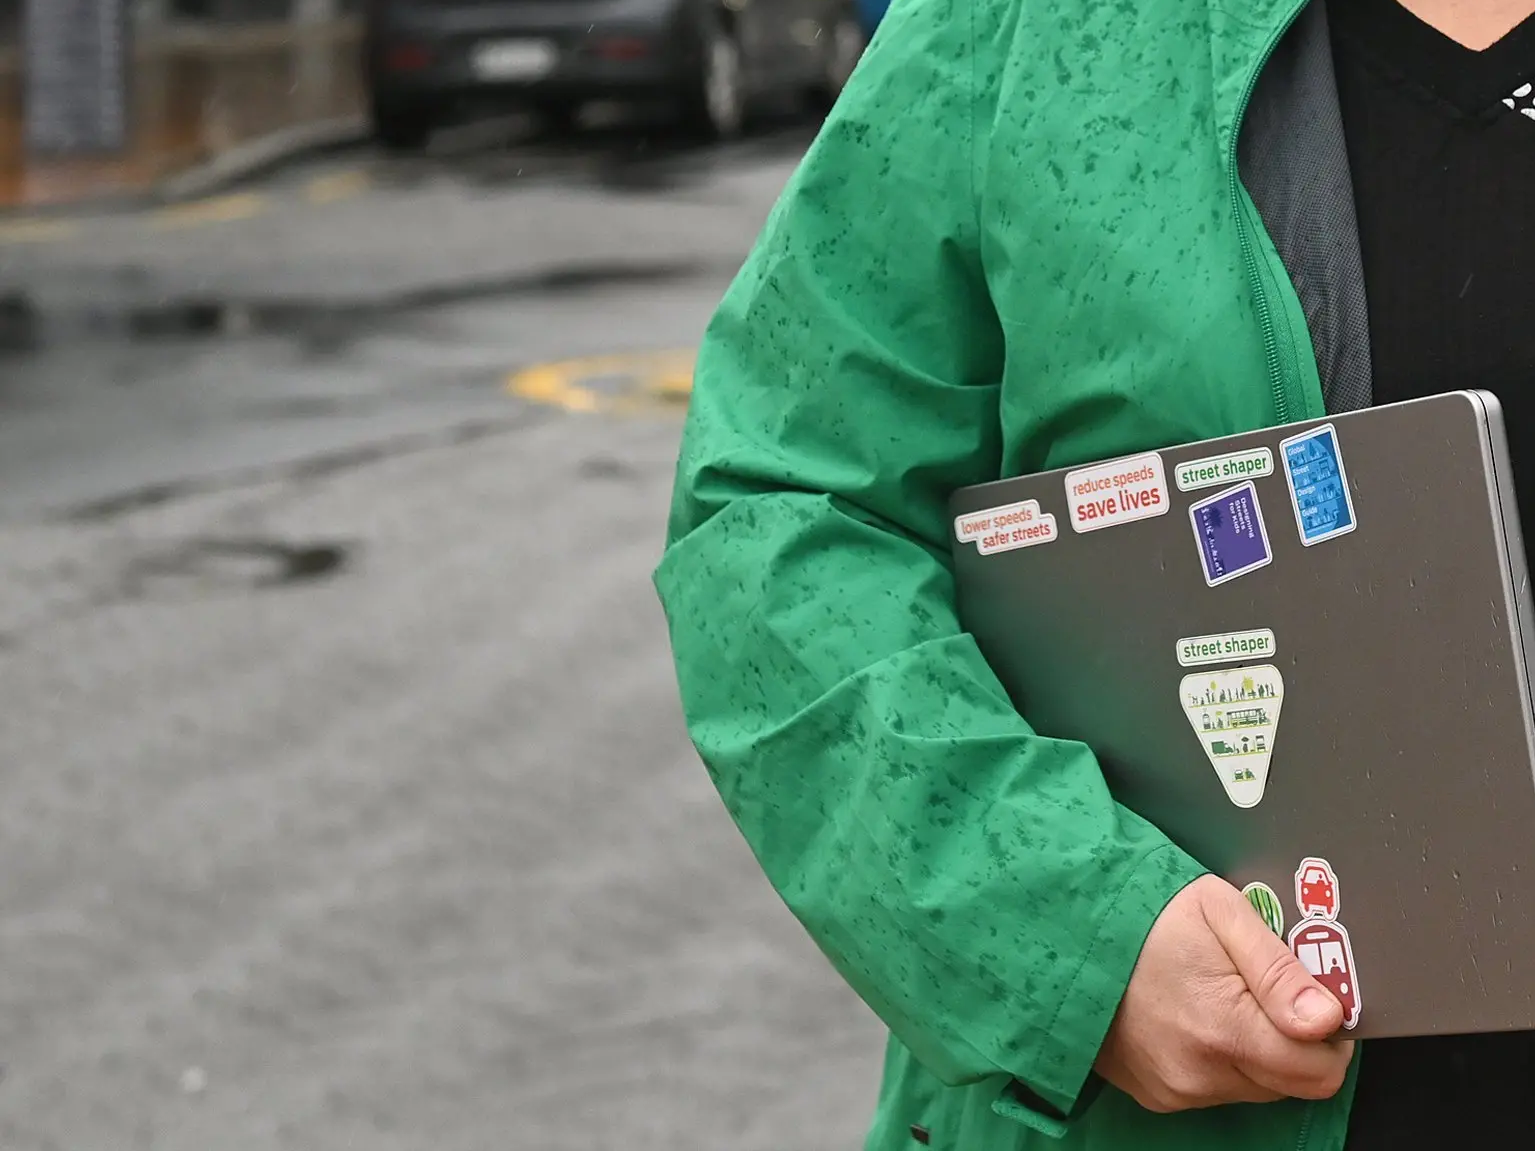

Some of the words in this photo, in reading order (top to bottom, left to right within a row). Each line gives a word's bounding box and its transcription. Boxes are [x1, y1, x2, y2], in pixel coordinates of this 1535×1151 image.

[1073, 477, 1111, 496] reduce
[1113, 465, 1154, 488] speeds
[1182, 463, 1220, 484] street
[1223, 457, 1266, 476] shaper
[1077, 497, 1117, 521] save
[1119, 488, 1160, 511] lives
[1234, 500, 1246, 530] Streets
[1240, 497, 1255, 538] Designing
[961, 519, 991, 535] lower
[993, 508, 1033, 529] speeds
[1232, 515, 1240, 534] Kids
[983, 531, 1010, 548] safer
[1012, 523, 1051, 542] streets
[1184, 640, 1222, 657] street
[1225, 637, 1269, 653] shaper
